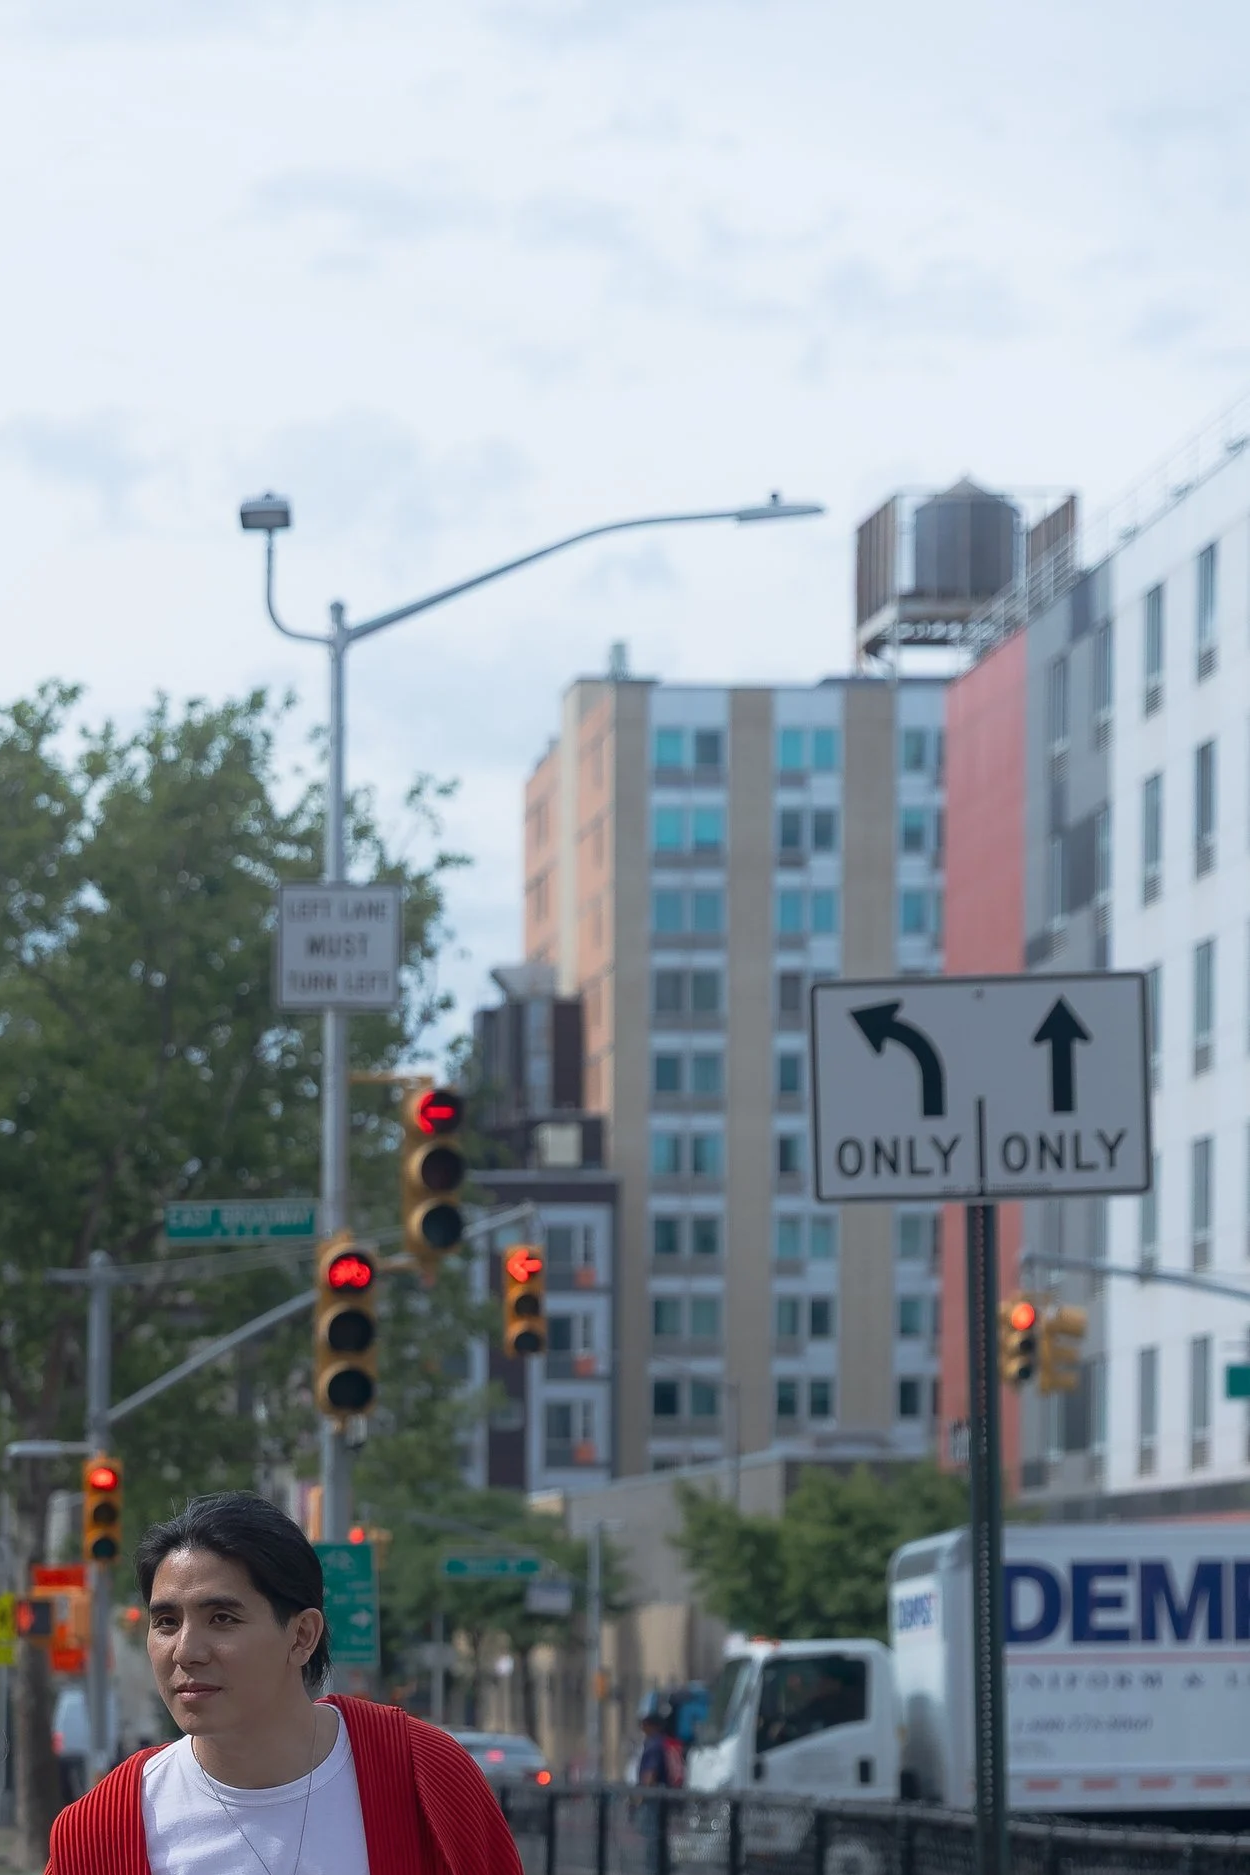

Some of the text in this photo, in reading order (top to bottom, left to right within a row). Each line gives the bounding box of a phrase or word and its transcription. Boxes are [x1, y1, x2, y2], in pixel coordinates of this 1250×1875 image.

[287, 899, 388, 921] LEFT LANE
[306, 934, 368, 959] MUST
[288, 970, 390, 994] TURN LEFT
[837, 1129, 1126, 1178] ONLY ONLY
[1003, 1561, 1250, 1643] DEM
